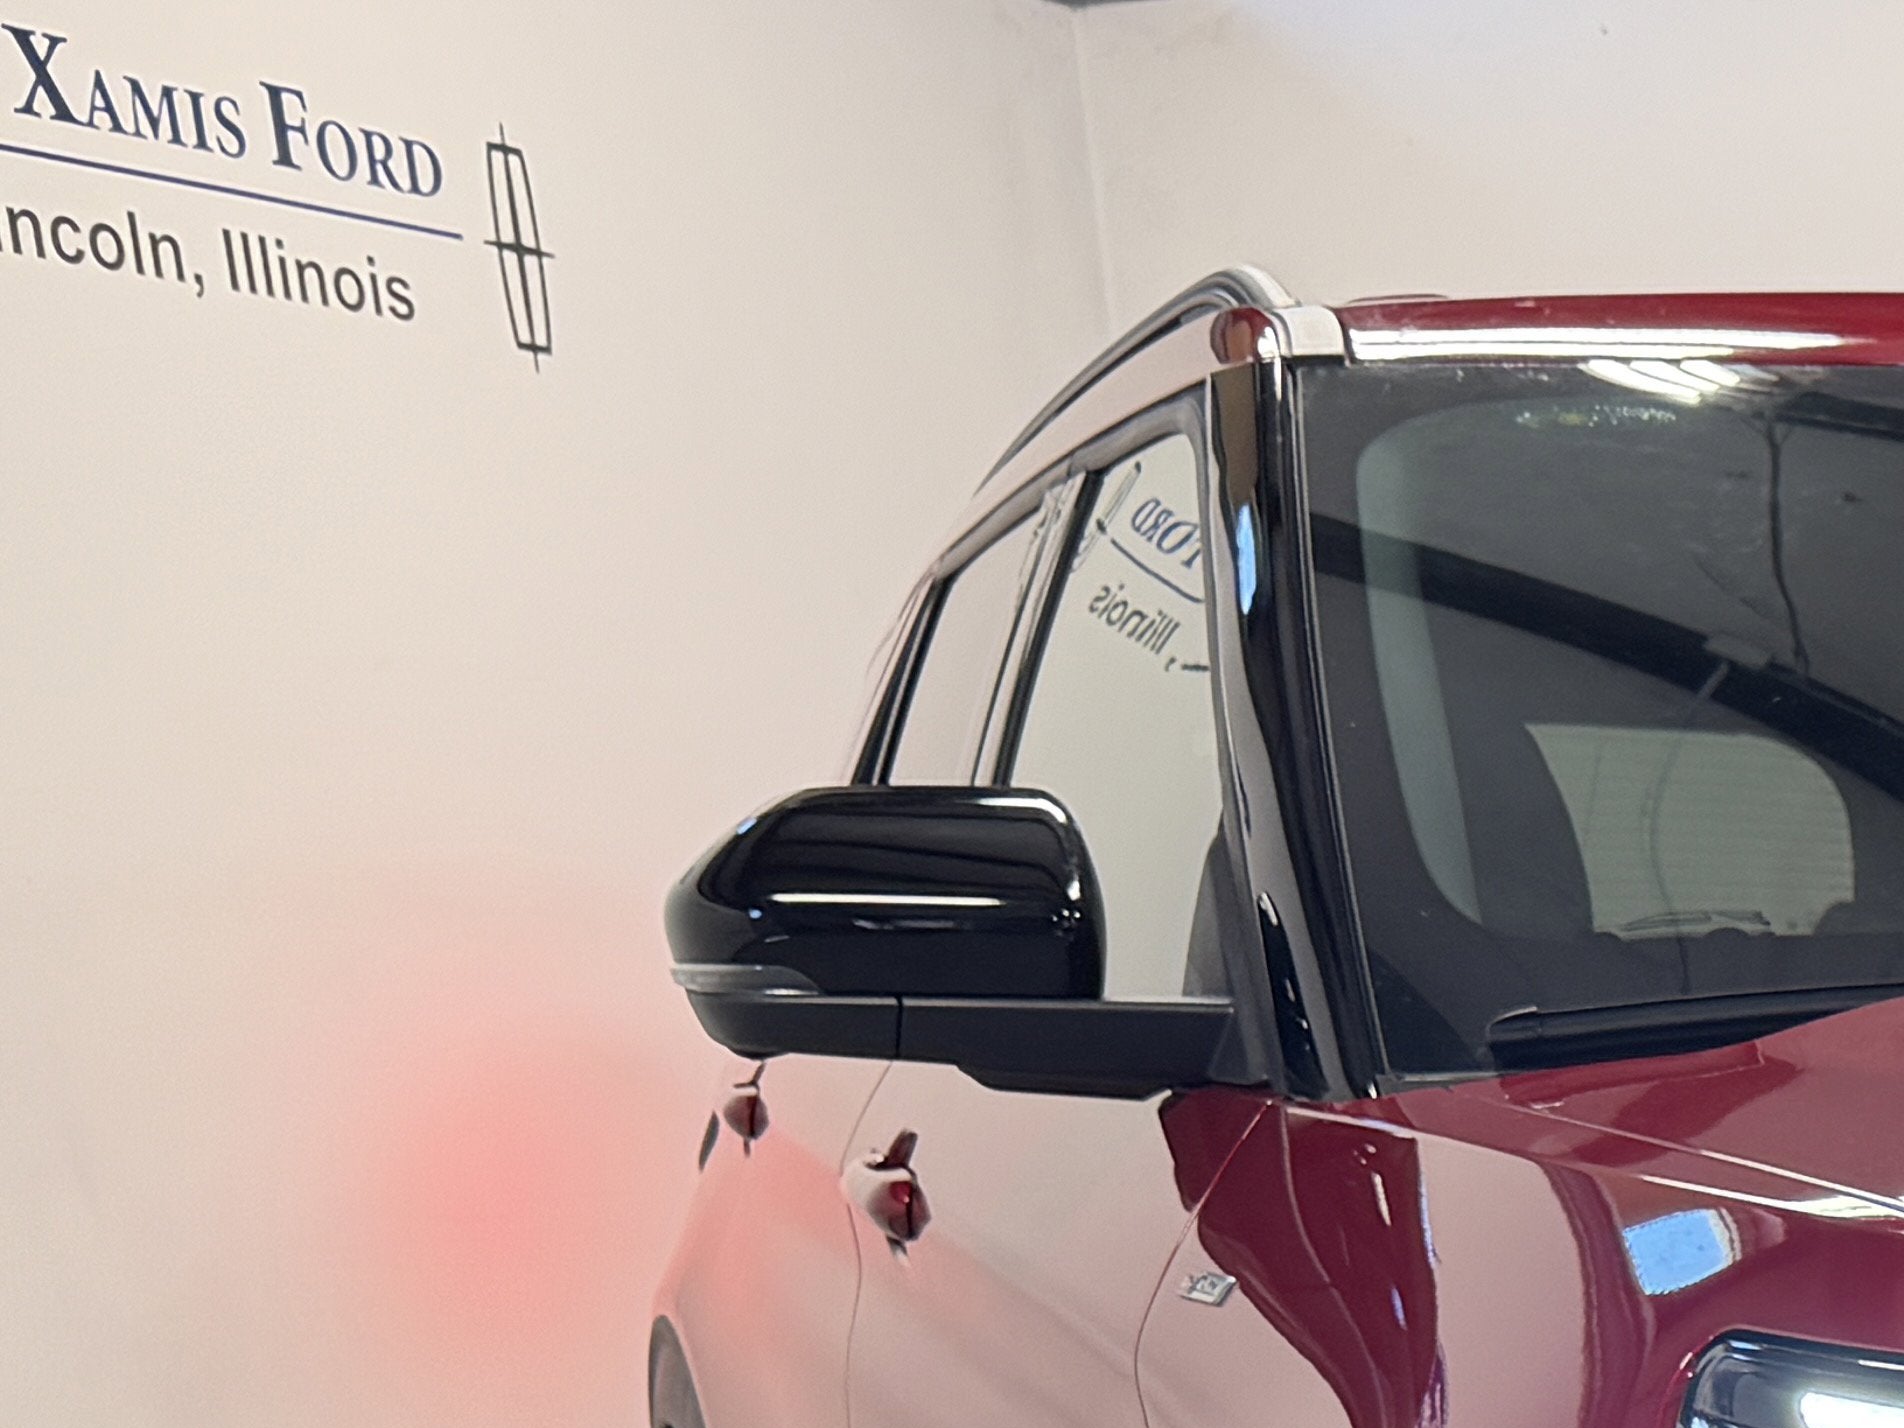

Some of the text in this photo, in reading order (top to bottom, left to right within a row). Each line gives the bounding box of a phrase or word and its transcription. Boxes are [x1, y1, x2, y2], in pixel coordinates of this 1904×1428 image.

[0, 23, 443, 197] XAMIS FORD
[0, 205, 416, 322] ncoln, Illinois
